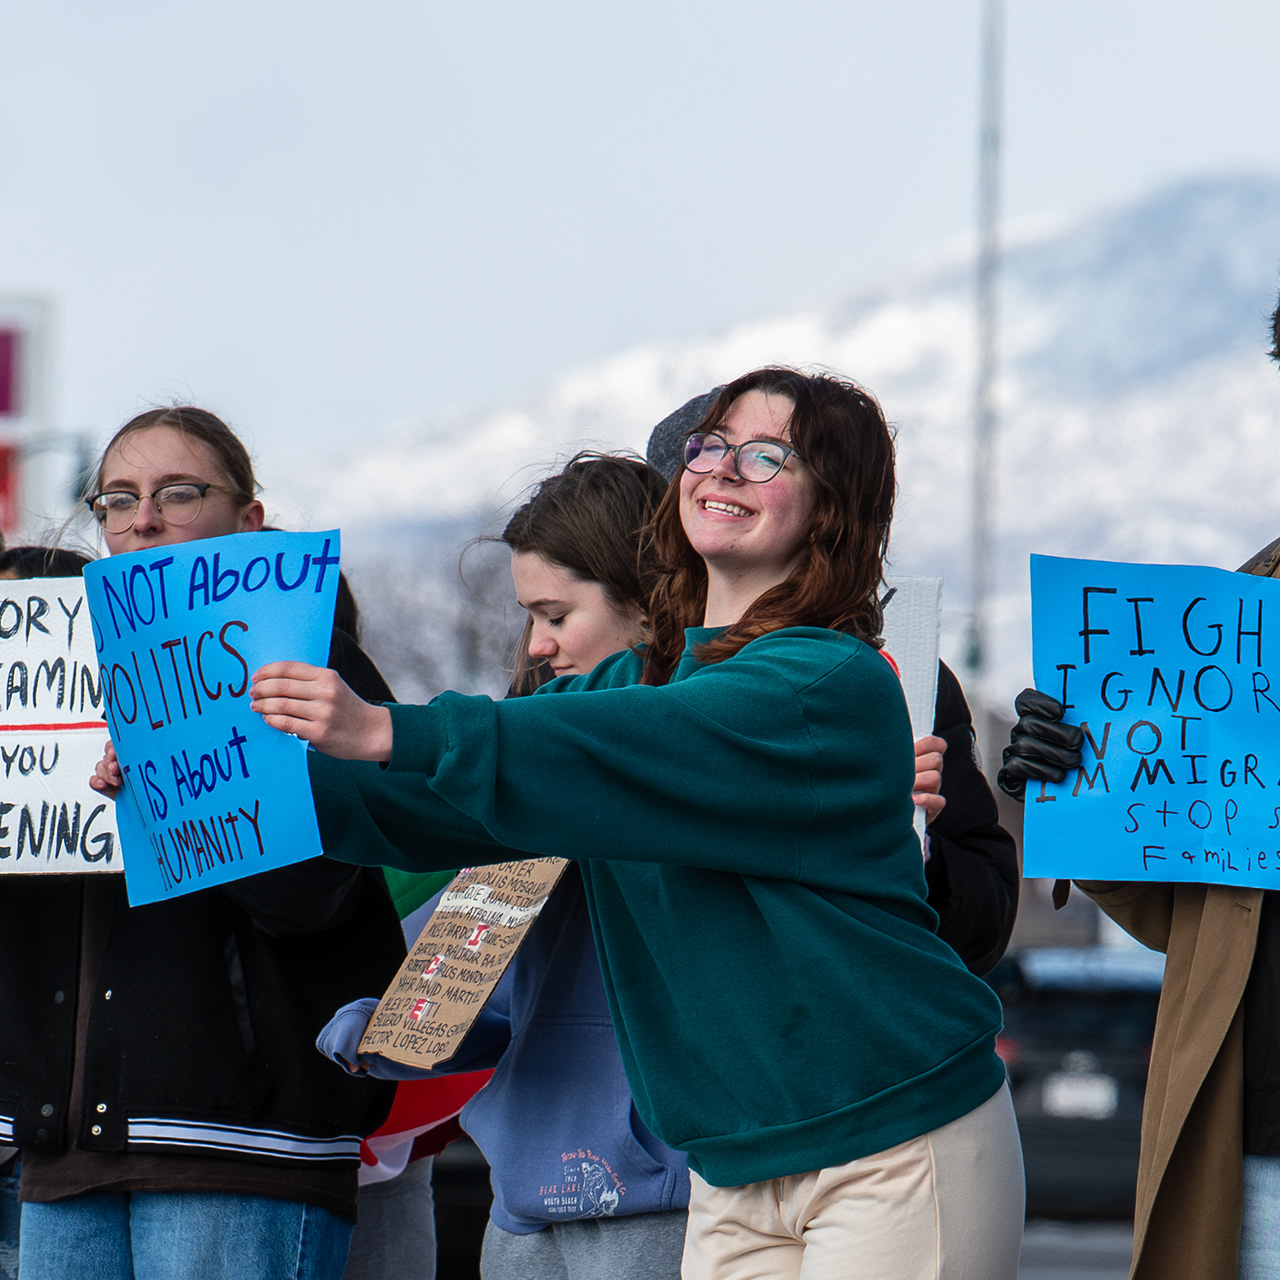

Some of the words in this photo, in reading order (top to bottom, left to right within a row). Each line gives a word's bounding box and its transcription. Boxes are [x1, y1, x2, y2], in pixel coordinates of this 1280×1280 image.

[102, 555, 175, 639] NOT
[0, 741, 60, 780] YOU
[1079, 713, 1203, 761] NOT
[137, 759, 168, 823] IS
[392, 1031, 428, 1055] LOPEZ
